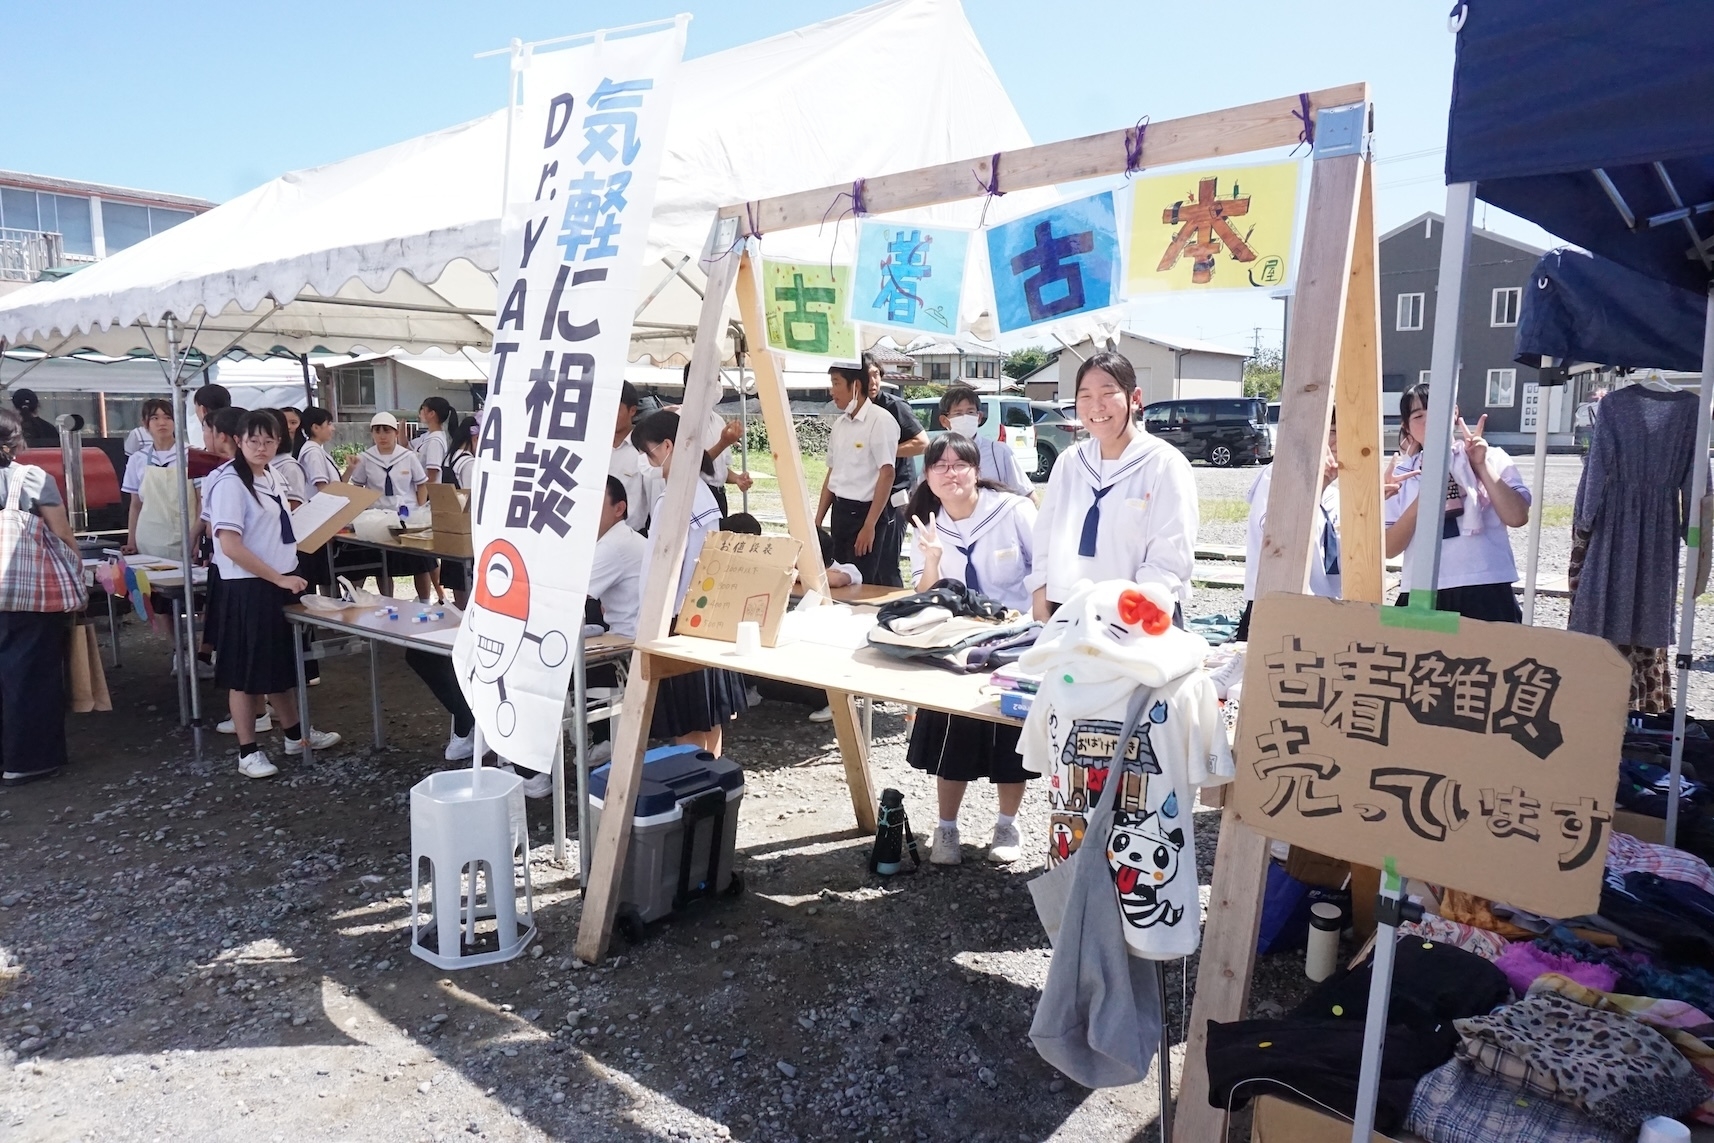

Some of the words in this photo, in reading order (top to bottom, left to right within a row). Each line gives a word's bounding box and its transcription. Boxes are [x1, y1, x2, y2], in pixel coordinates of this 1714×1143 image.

[505, 77, 654, 538] 気軽に相談
[720, 540, 773, 555] お値段表
[1077, 736, 1136, 755] おばけやき
[1264, 634, 1564, 760] 古着雑貨
[1252, 718, 1611, 871] 売っています
